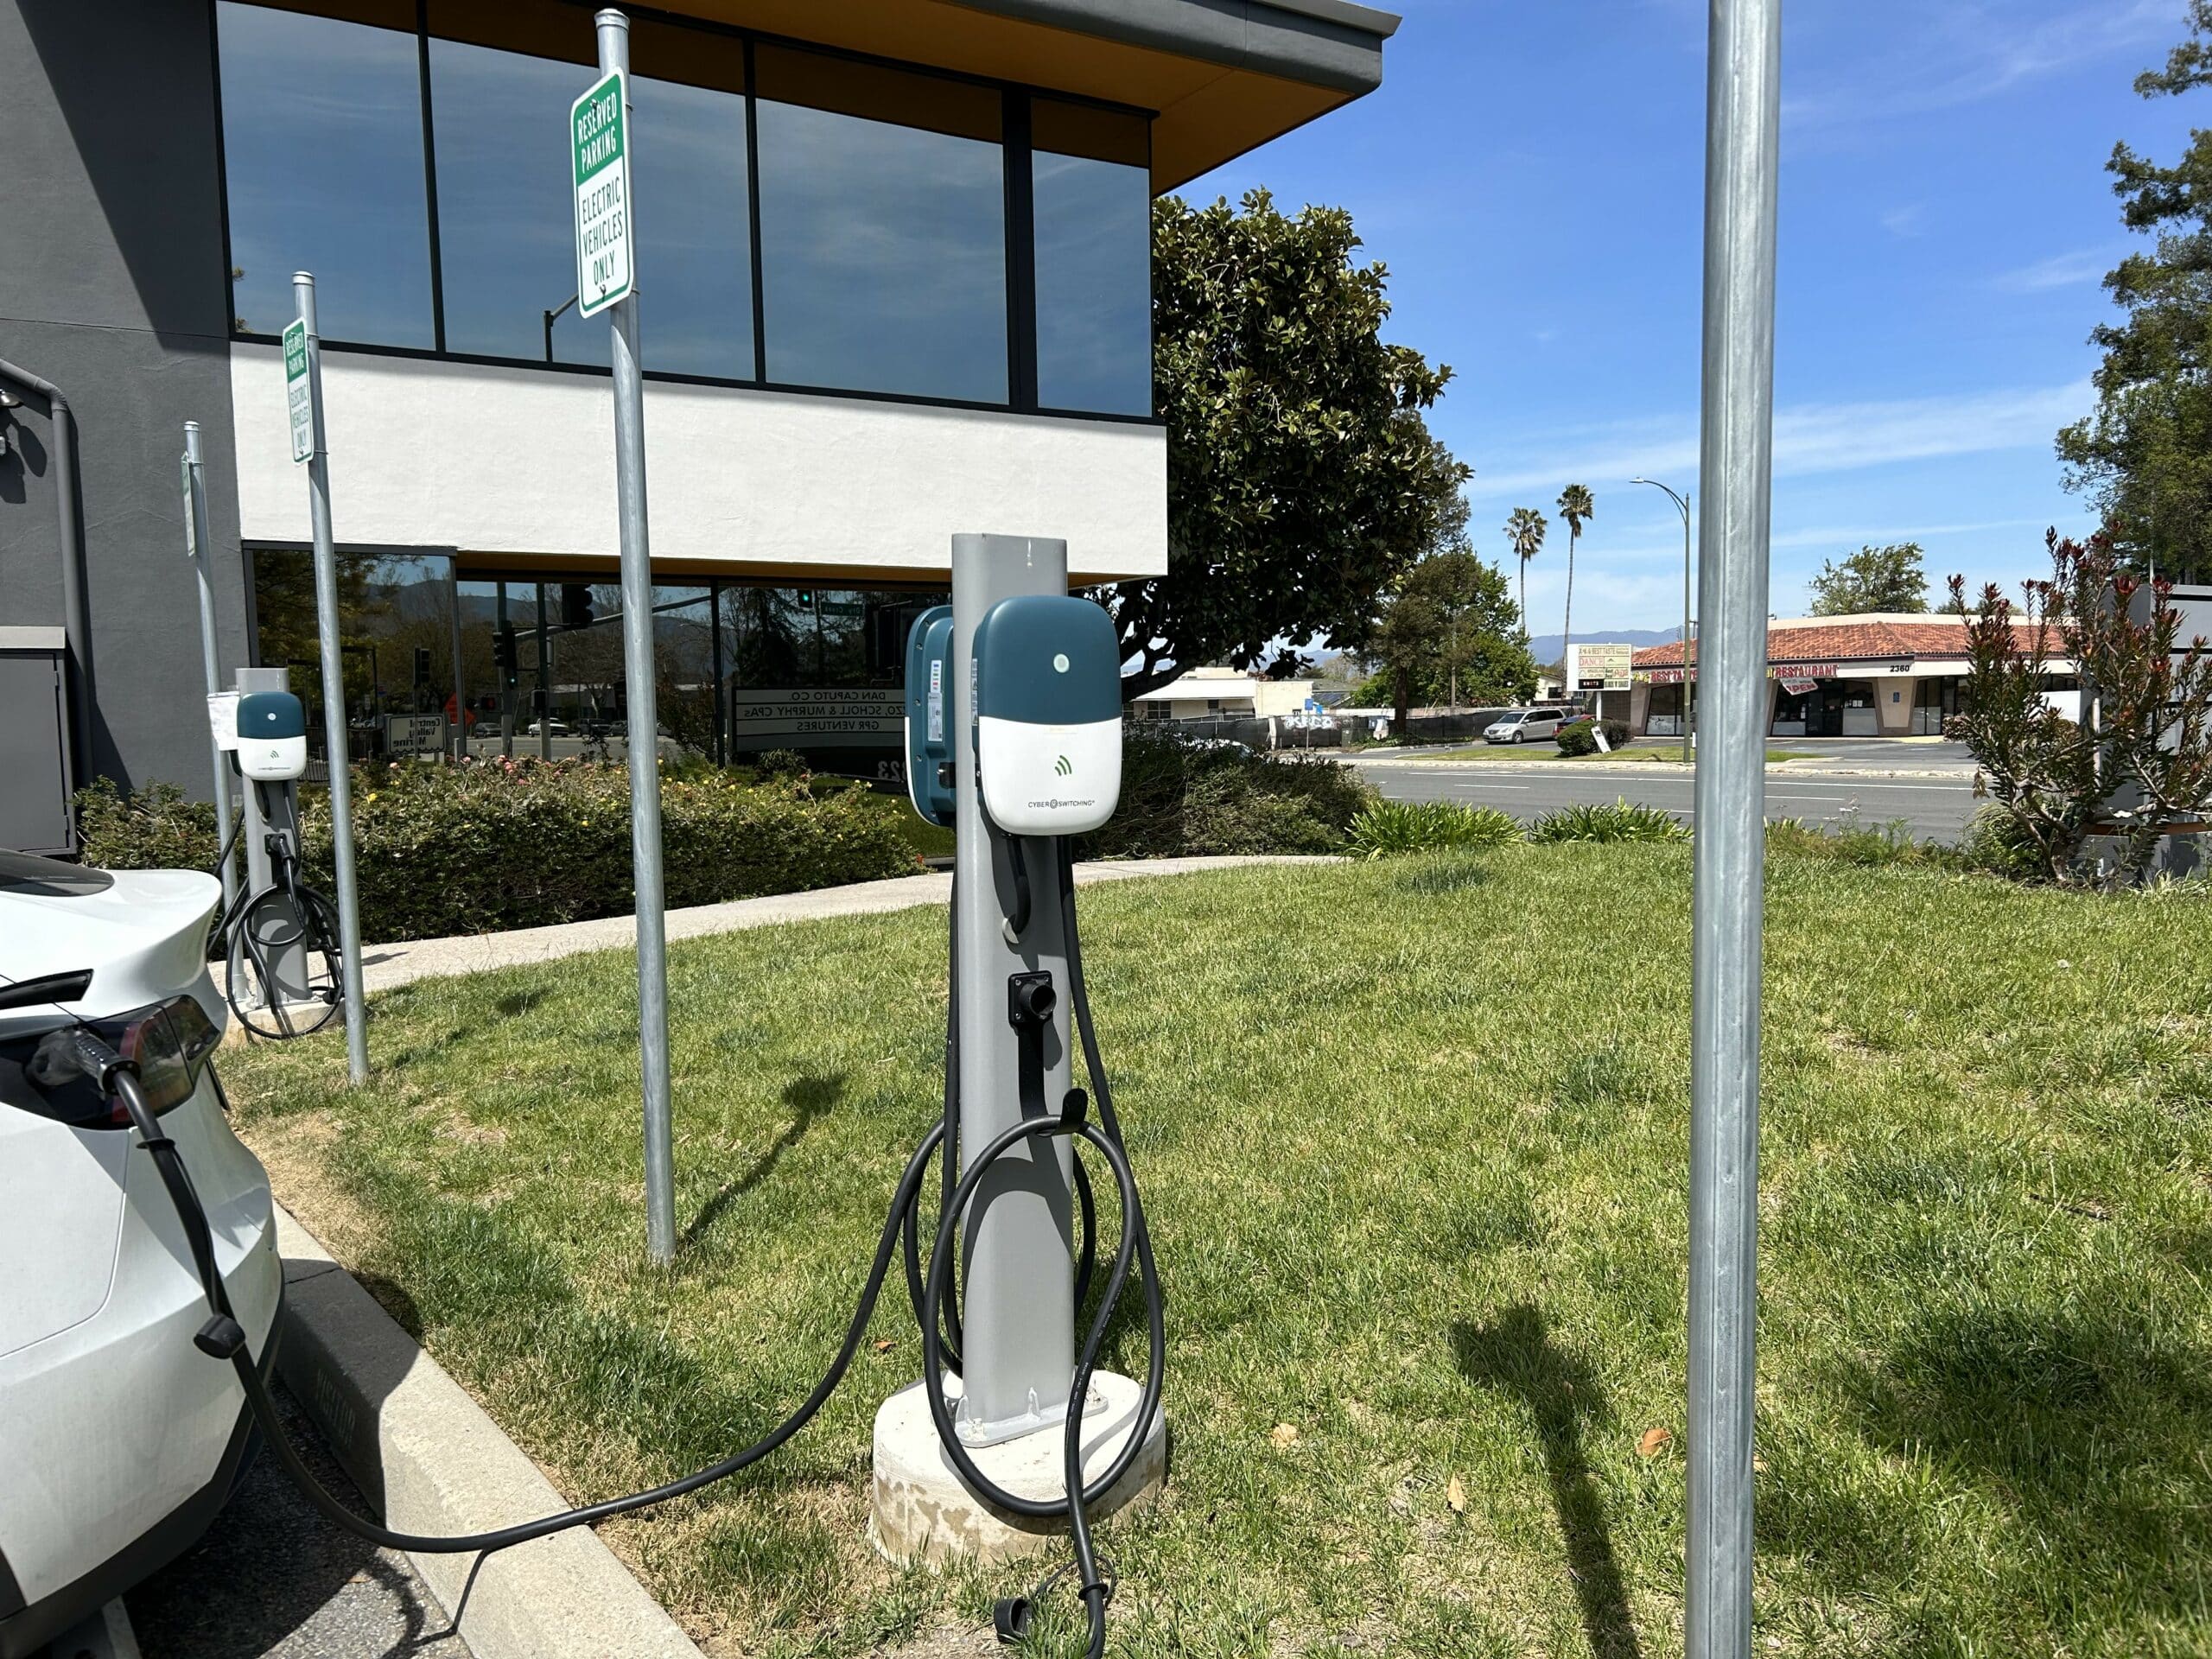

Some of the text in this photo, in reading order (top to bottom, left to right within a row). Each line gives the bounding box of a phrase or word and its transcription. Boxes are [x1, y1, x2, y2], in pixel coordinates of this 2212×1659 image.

[578, 92, 617, 144] RESERVED
[581, 125, 617, 174] PARKING
[582, 175, 621, 225] ELECTRIC
[583, 210, 623, 257] VEHICLES
[593, 249, 615, 286] ONLY
[1579, 658, 1604, 666] DANCE
[1672, 670, 1698, 681] TATE
[1775, 664, 1840, 678] RESTAURANT
